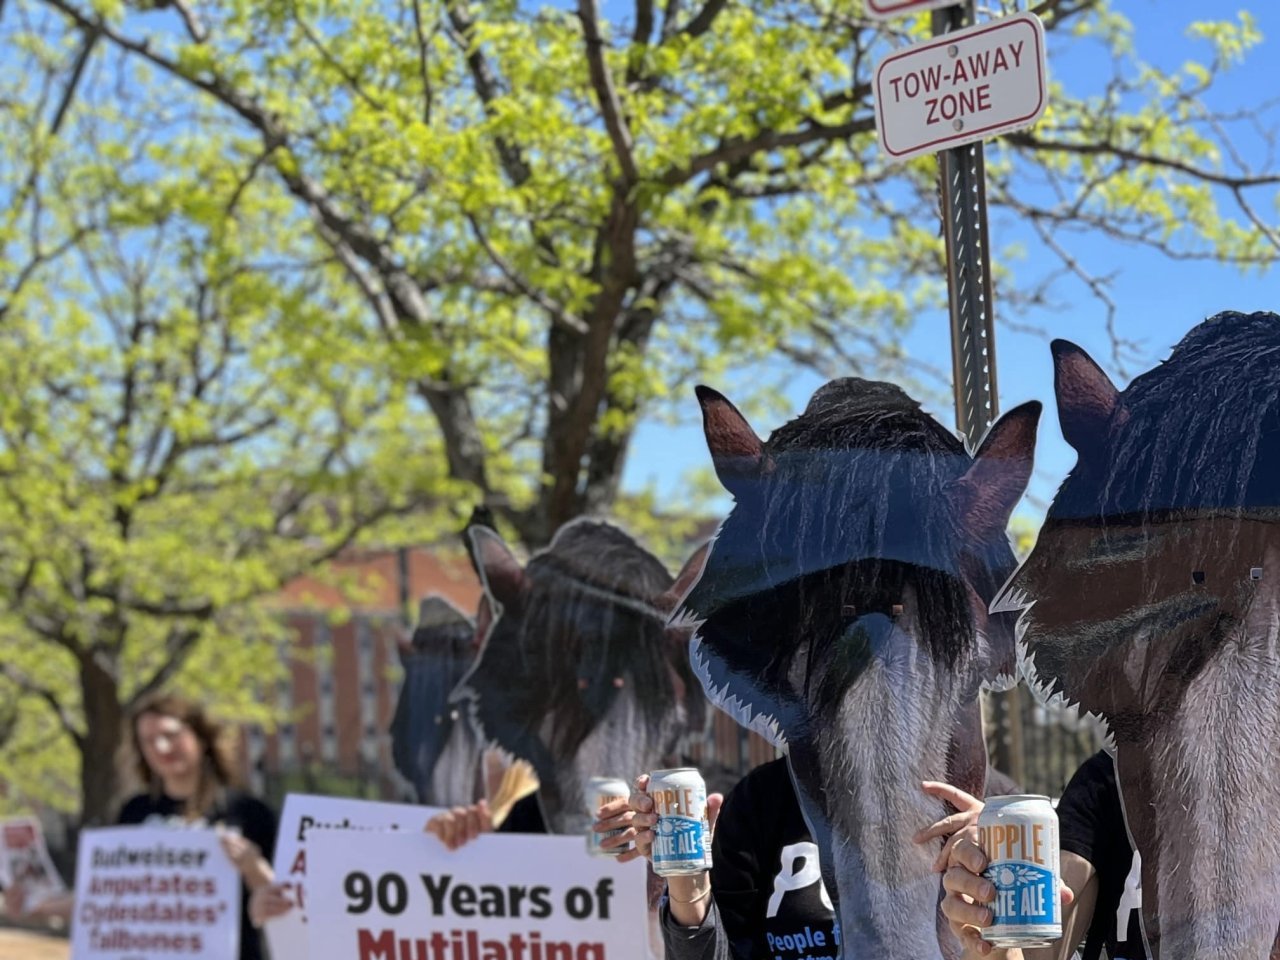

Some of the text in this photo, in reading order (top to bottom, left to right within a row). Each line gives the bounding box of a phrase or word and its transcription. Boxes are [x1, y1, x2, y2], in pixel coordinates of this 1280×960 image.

[889, 40, 1024, 103] TOW-AWAY
[925, 84, 992, 125] ZONE
[652, 789, 695, 817] PPLE
[679, 831, 698, 854] ALE
[344, 871, 408, 915] 90
[420, 874, 553, 918] Years
[564, 877, 614, 919] of
[988, 884, 1046, 917] ITE ALE
[767, 926, 826, 953] People
